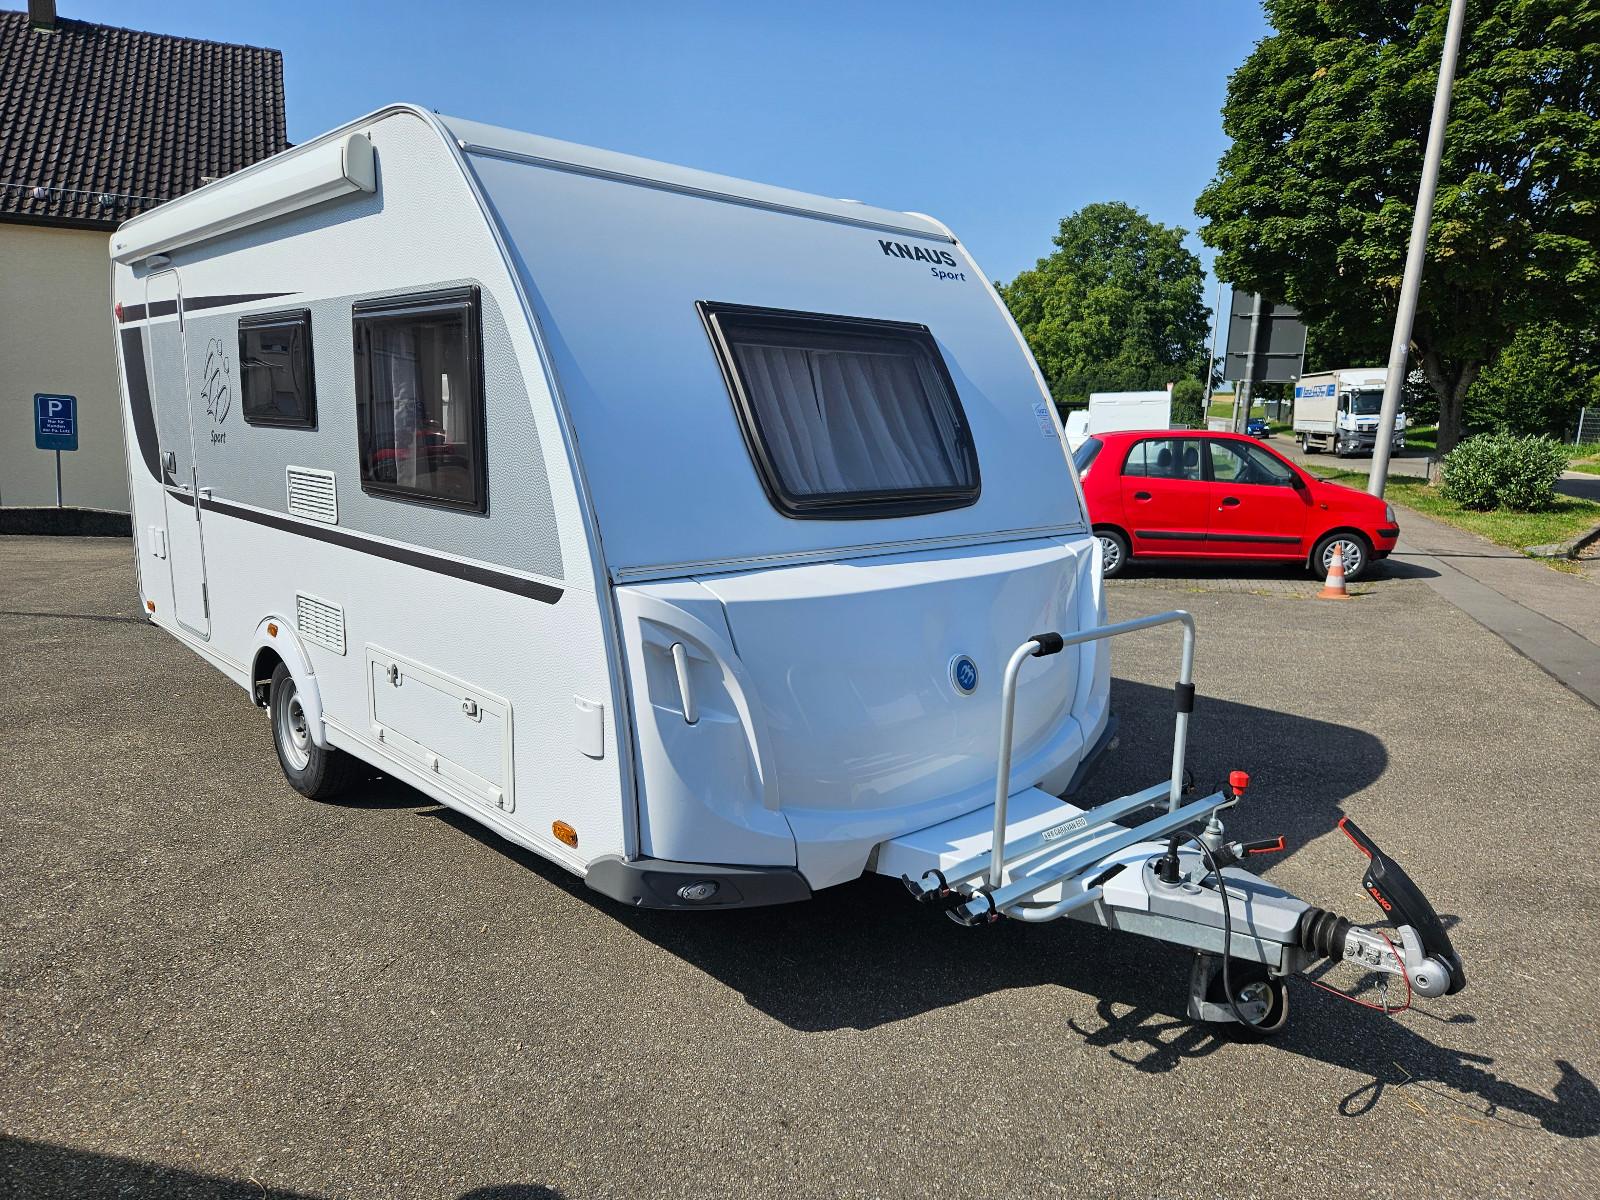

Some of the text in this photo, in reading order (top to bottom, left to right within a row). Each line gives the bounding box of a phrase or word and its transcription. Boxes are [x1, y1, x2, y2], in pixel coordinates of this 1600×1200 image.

[878, 240, 957, 268] KNAUS
[931, 267, 967, 281] Sport
[48, 400, 62, 417] P
[210, 430, 226, 446] Sport
[1053, 822, 1077, 836] CARAVAN
